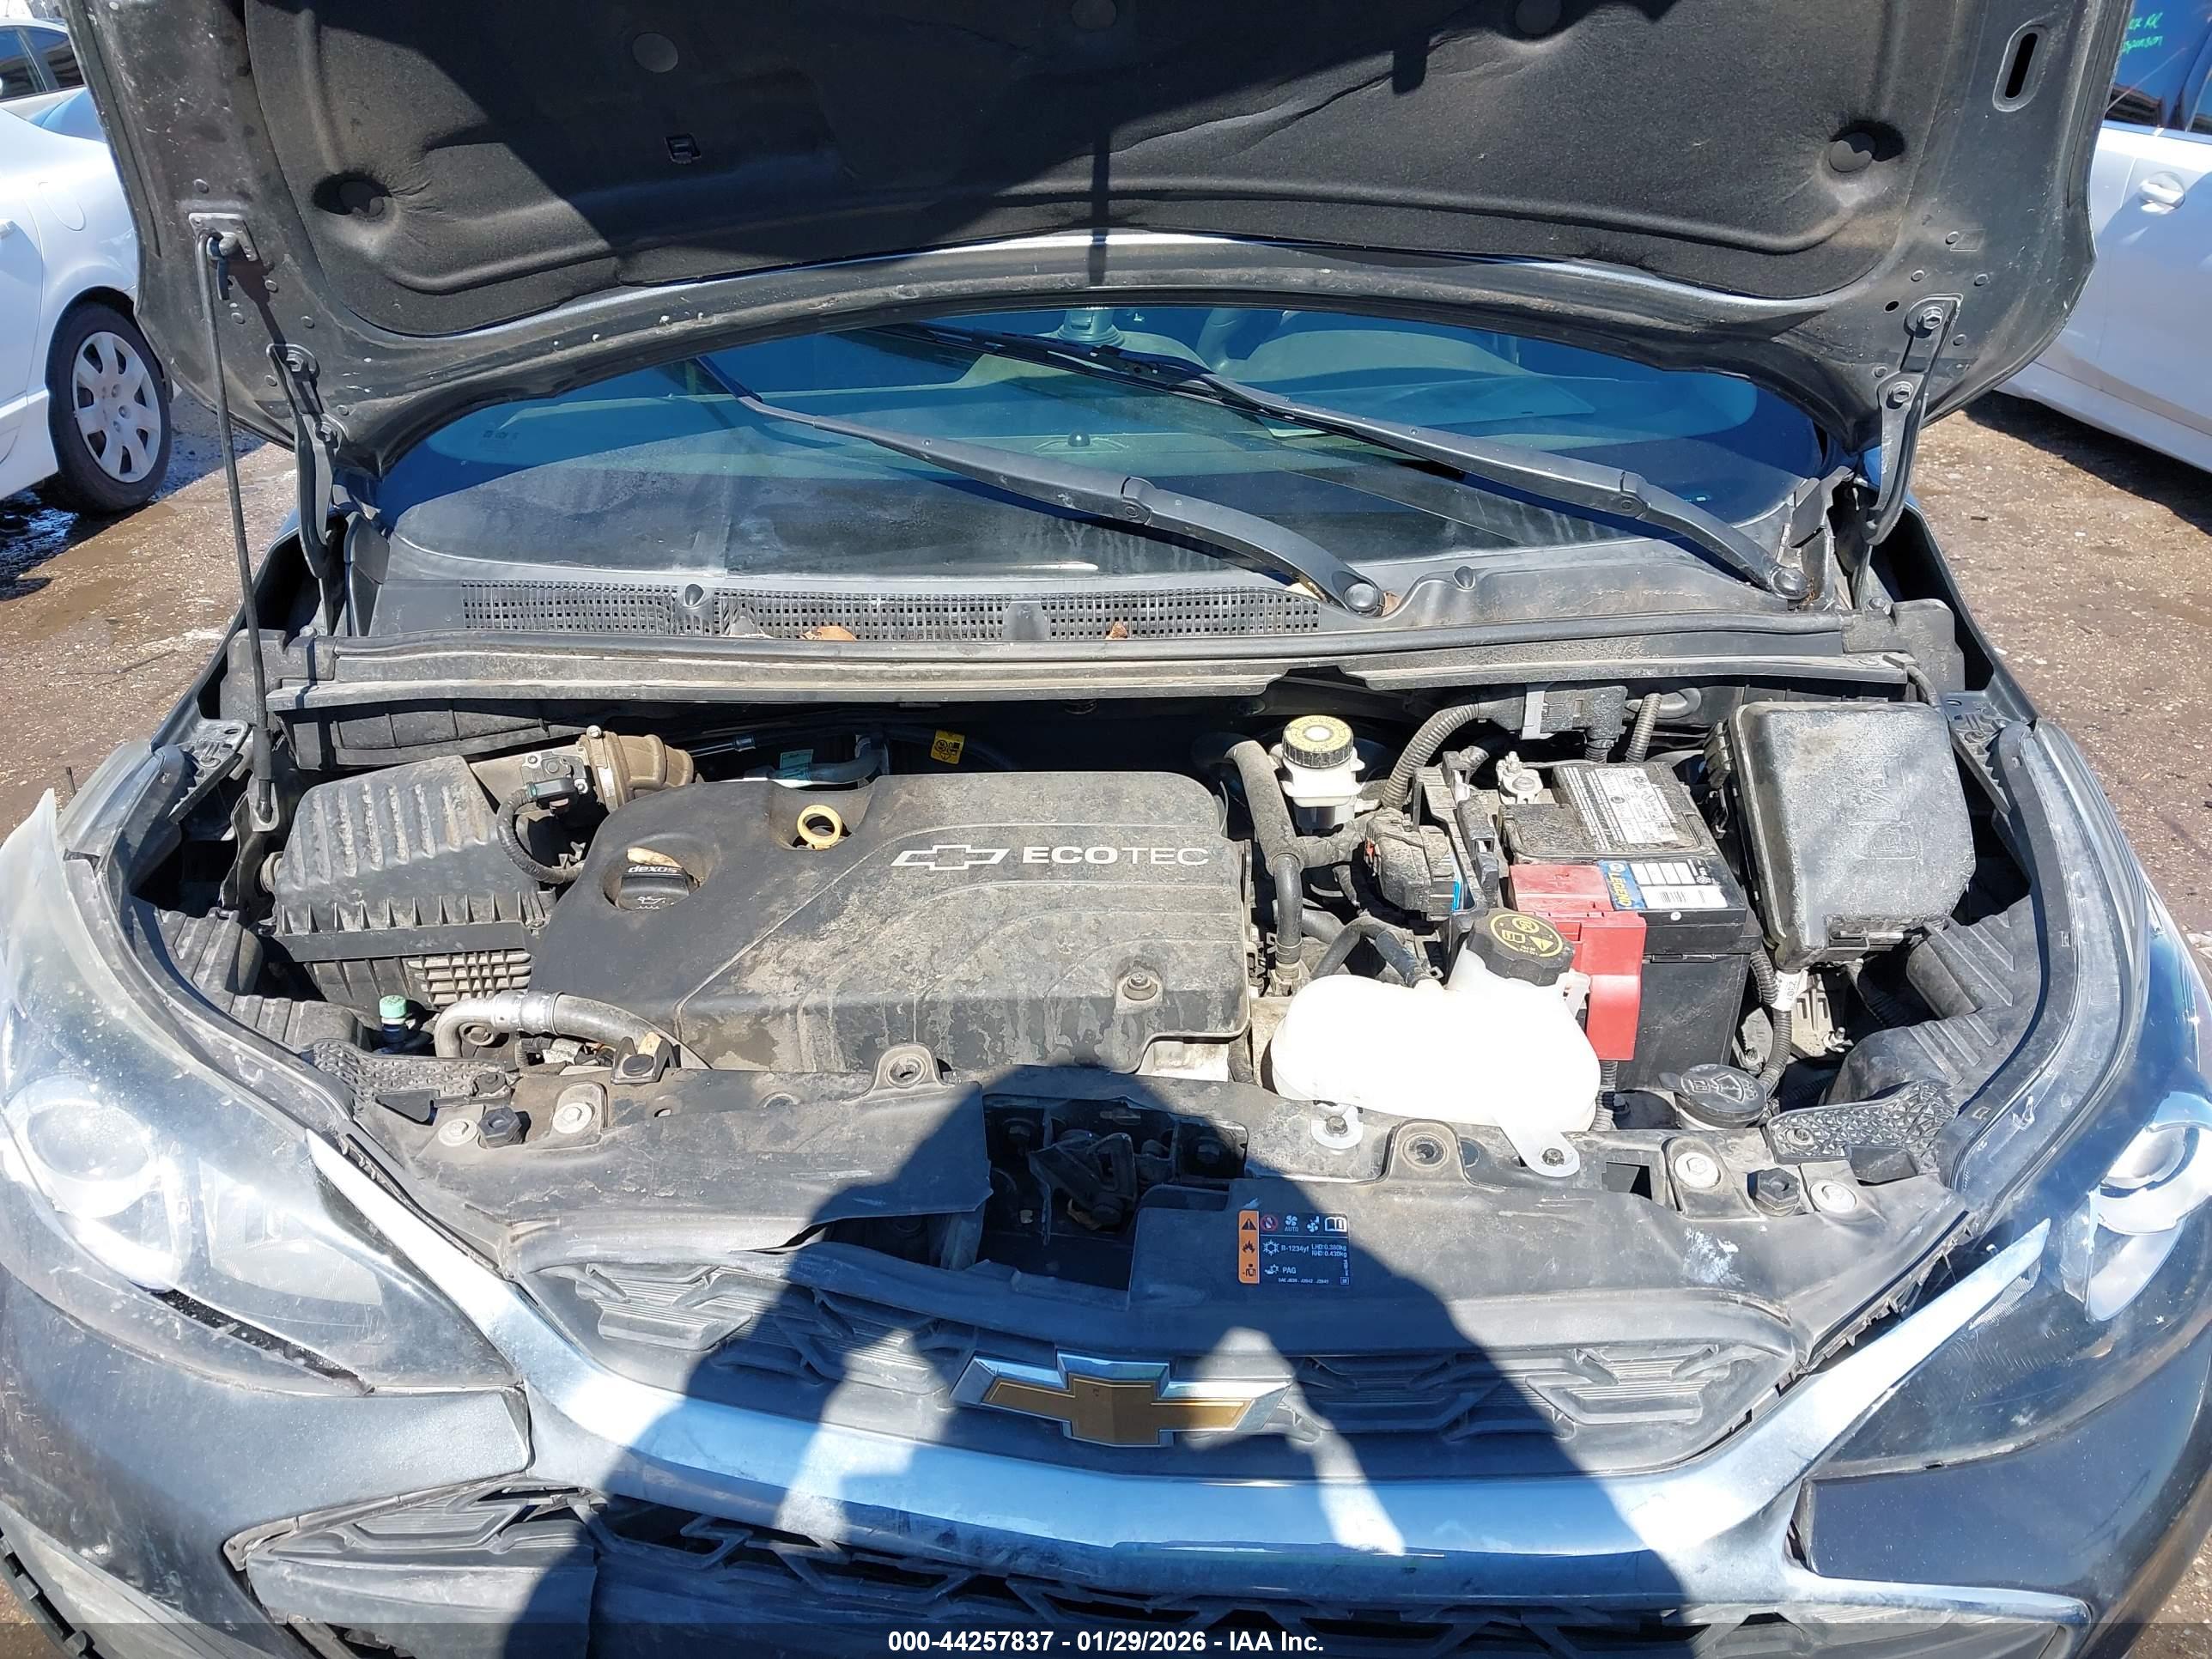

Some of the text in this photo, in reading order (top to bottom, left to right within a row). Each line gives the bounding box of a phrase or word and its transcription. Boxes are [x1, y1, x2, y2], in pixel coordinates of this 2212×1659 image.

[1023, 846, 1209, 866] ECOTEC
[628, 865, 678, 873] dexos
[1607, 871, 1632, 907] LEGEND
[1282, 1266, 1297, 1274] PAG
